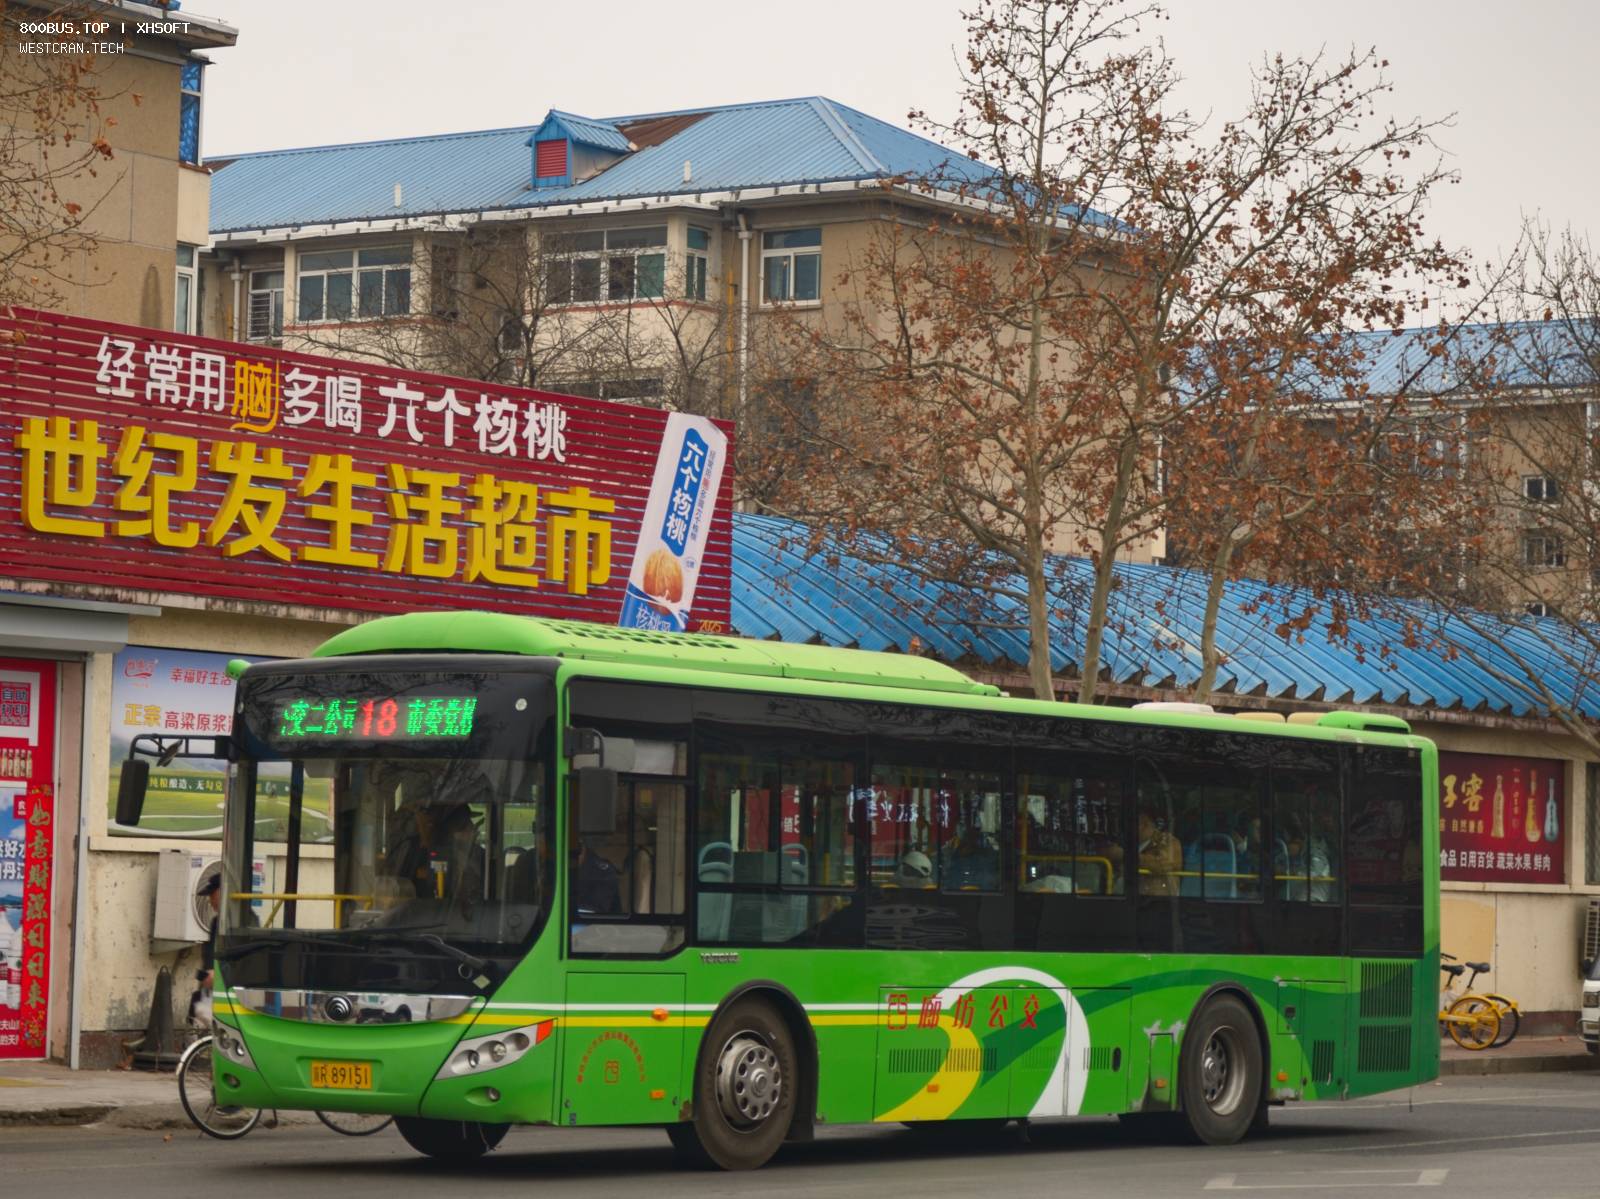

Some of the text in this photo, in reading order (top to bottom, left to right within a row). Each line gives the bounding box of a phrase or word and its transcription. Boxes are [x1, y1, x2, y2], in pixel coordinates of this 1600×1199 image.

[15, 416, 615, 596] 世纪发生活超市
[664, 438, 706, 546] 六个核桃
[123, 703, 161, 727] 正宗
[362, 699, 399, 736] 18
[917, 994, 1040, 1029] 廊坊公交
